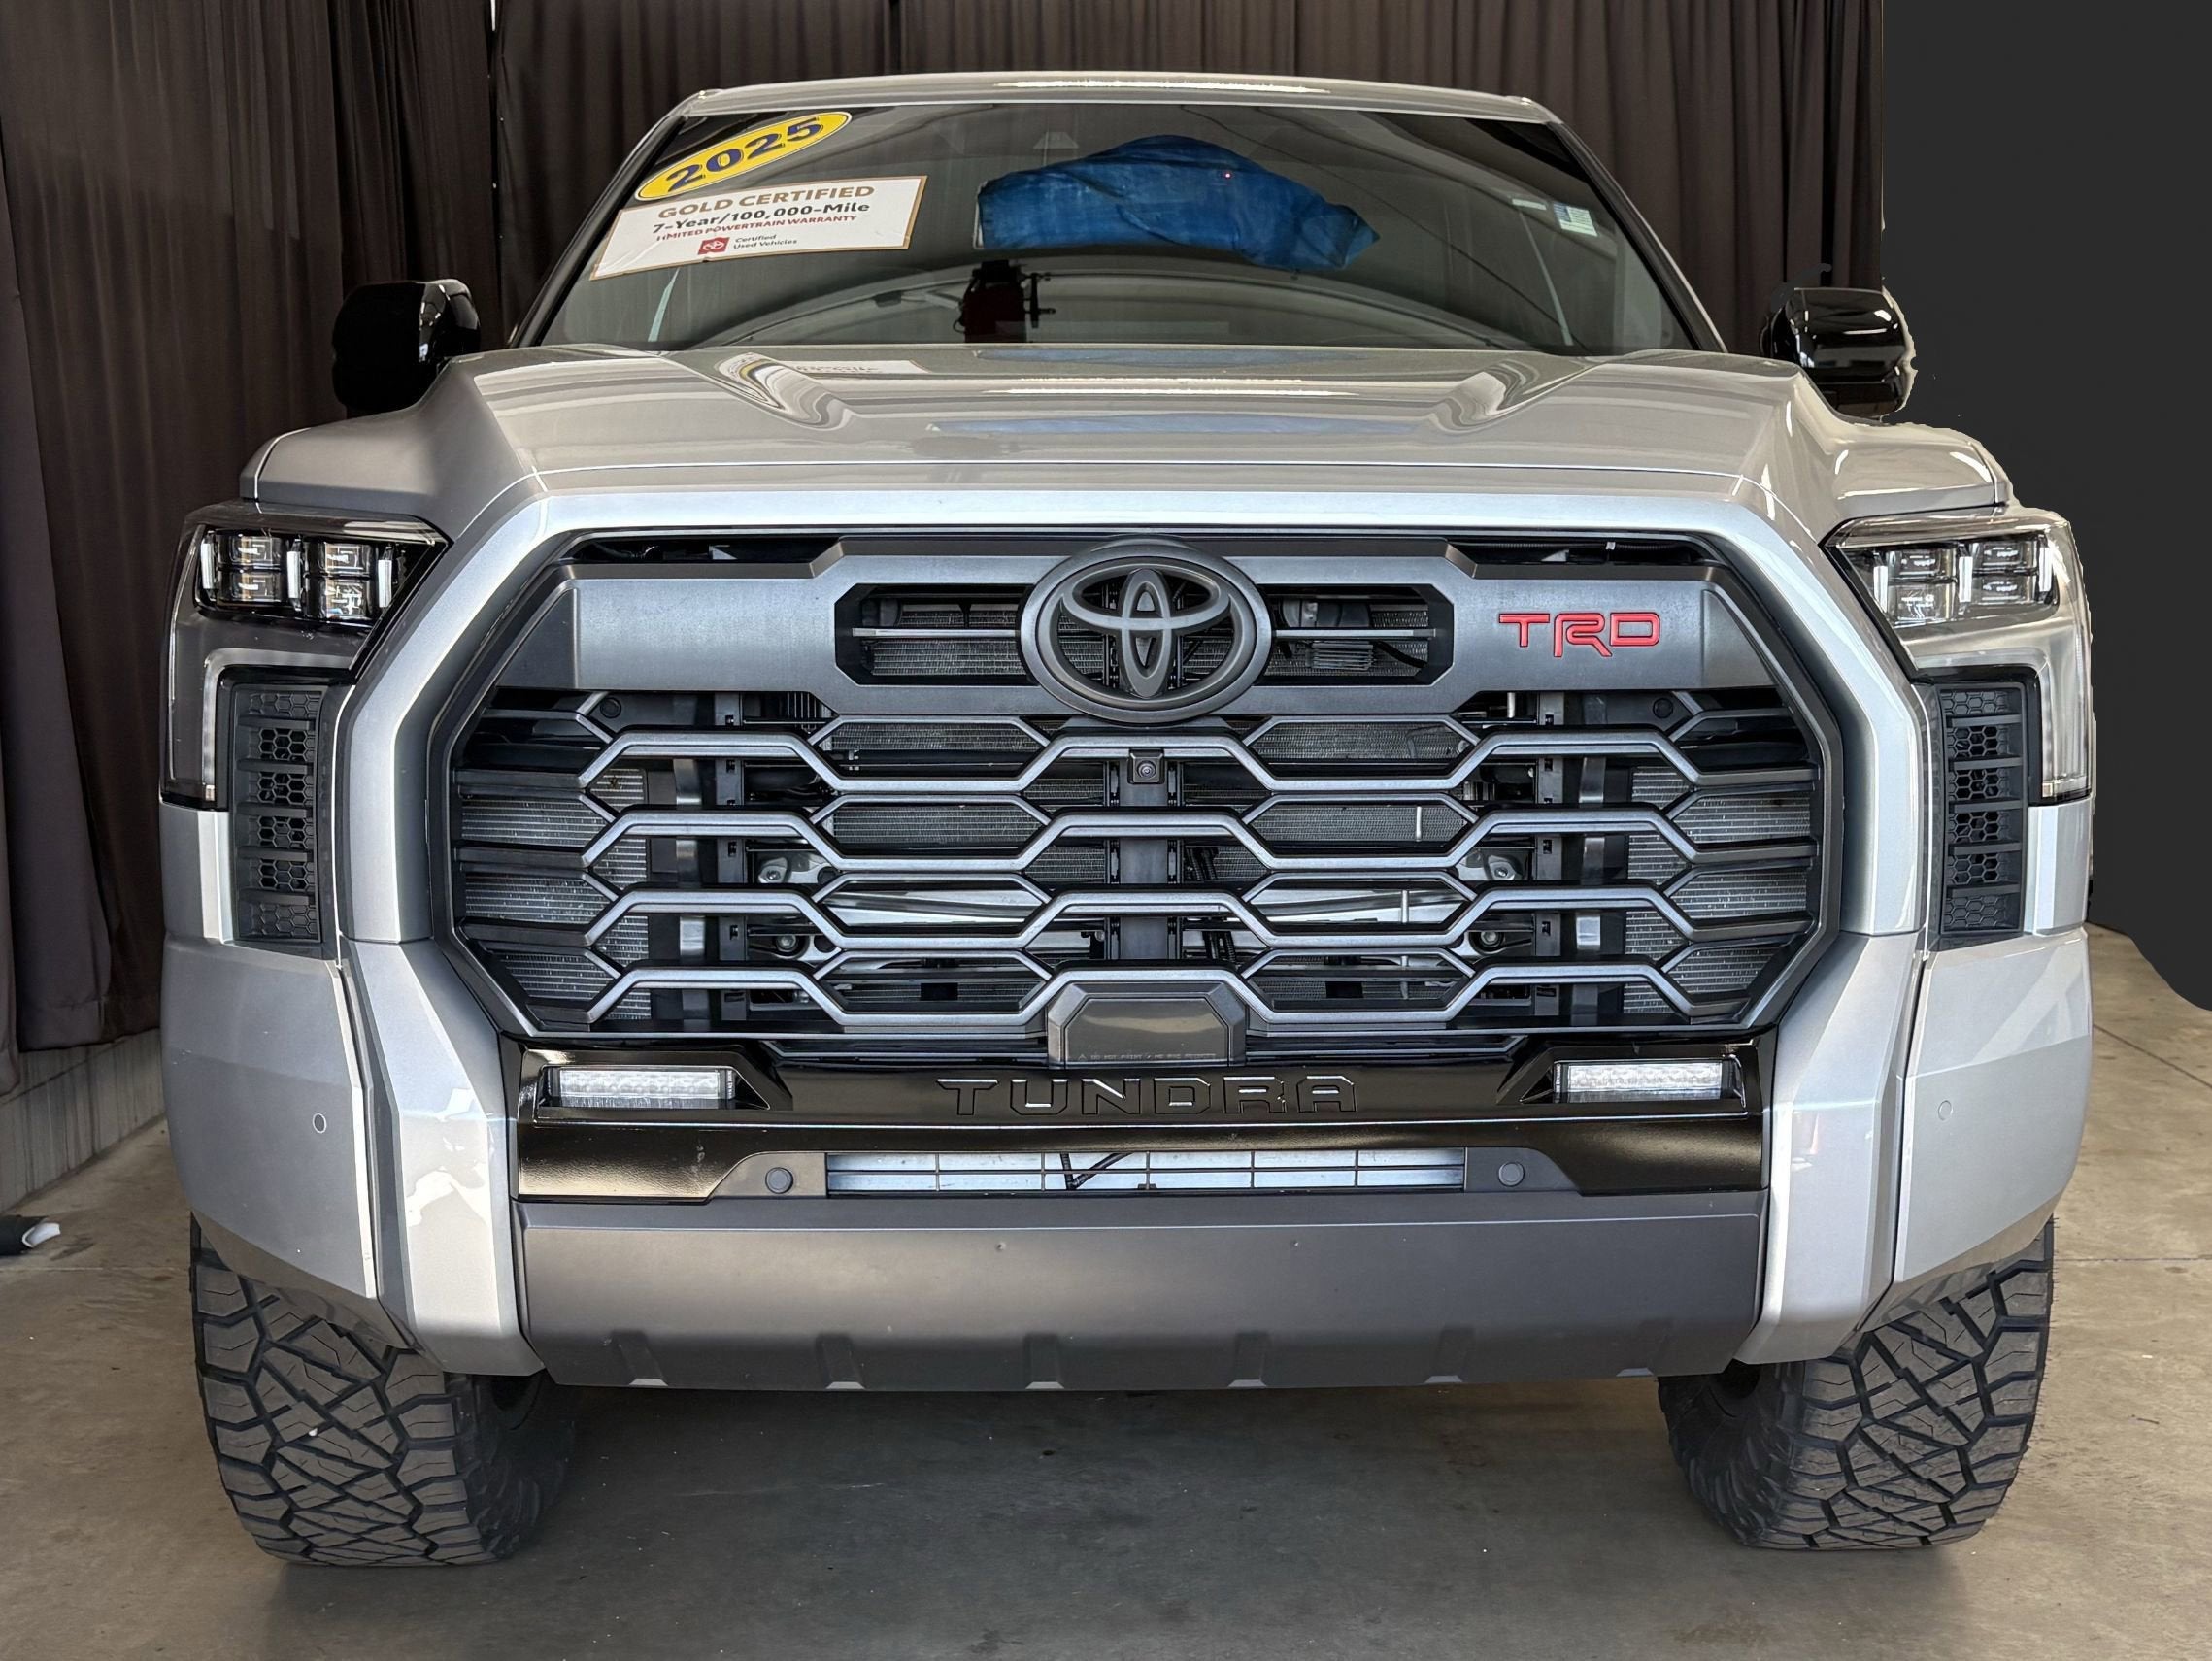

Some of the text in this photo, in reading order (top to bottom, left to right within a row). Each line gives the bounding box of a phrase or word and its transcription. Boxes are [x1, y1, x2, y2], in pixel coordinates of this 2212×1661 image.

[665, 116, 823, 192] 2025
[653, 202, 870, 233] 7-Year/100,000-Mile
[658, 186, 875, 218] GOLD CERTIFIED
[705, 219, 785, 233] POWERTRAIN
[788, 216, 856, 225] WARRANTY
[1498, 612, 1660, 657] TRD
[936, 1075, 1357, 1115] TUNDRA
